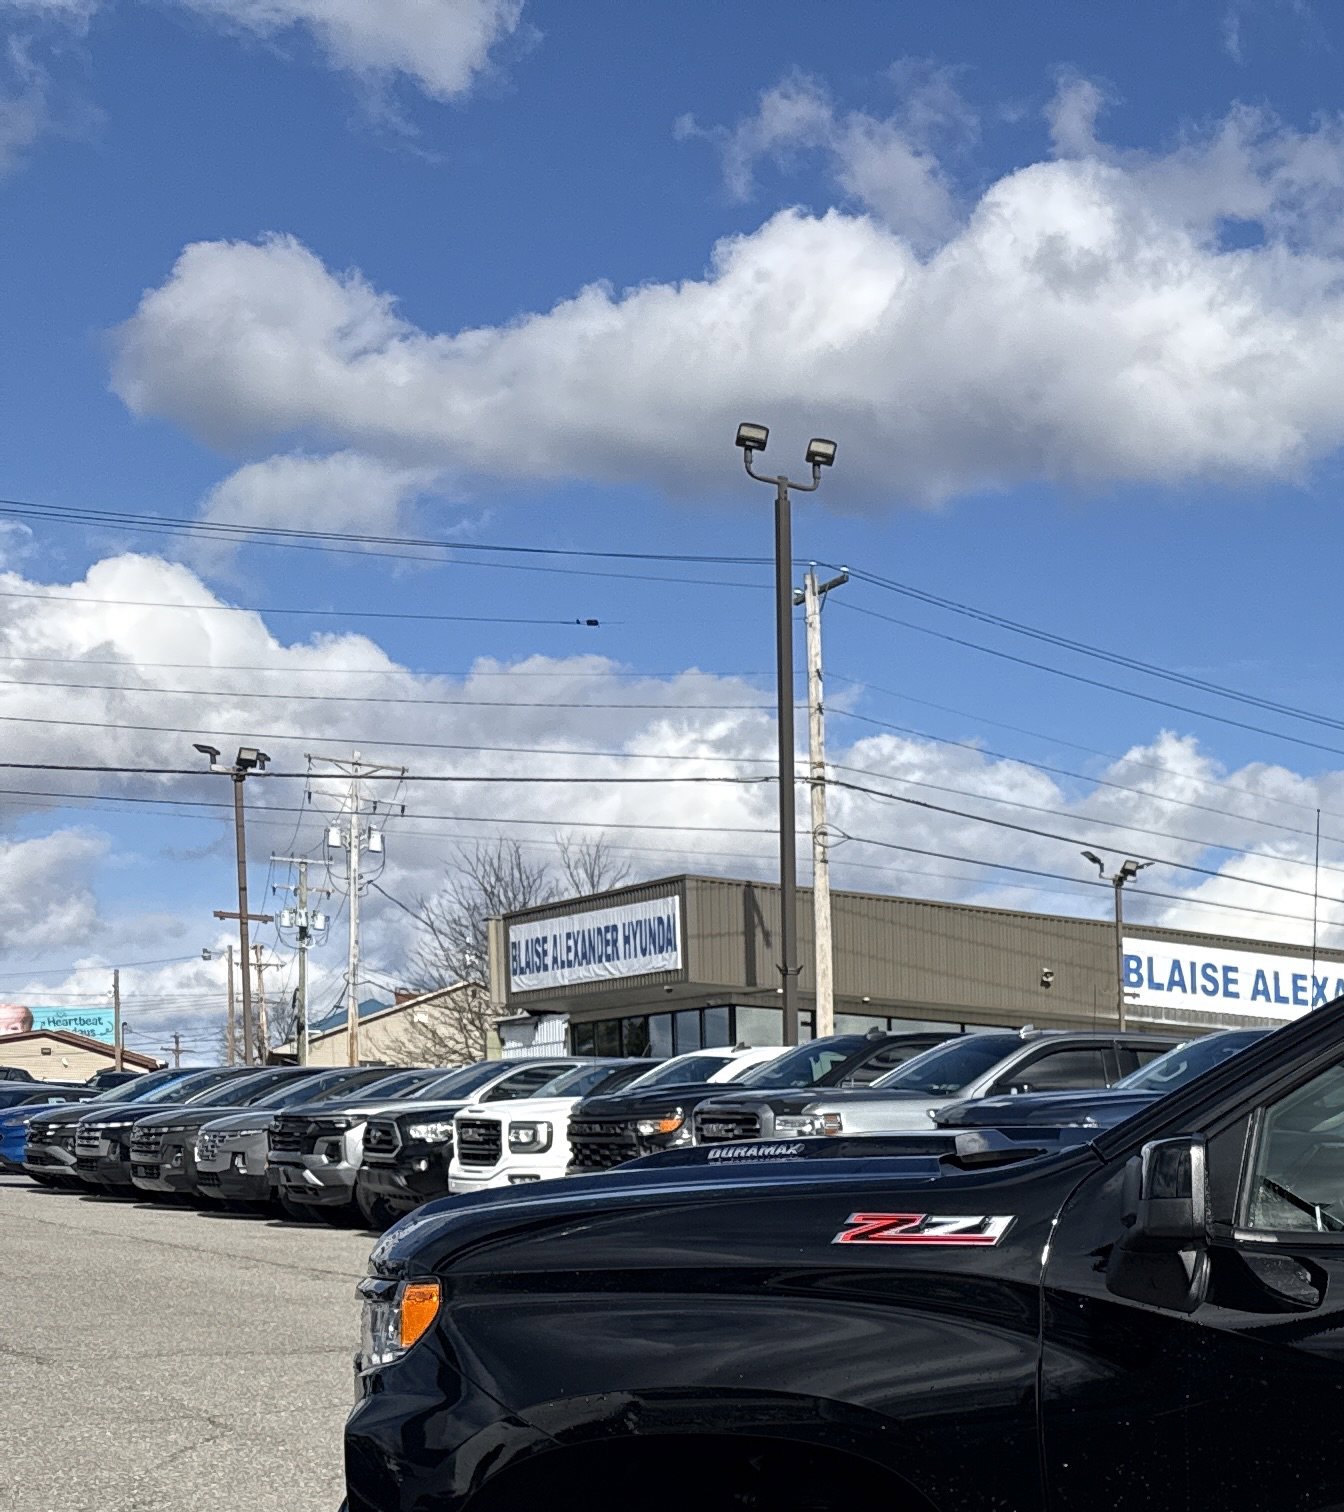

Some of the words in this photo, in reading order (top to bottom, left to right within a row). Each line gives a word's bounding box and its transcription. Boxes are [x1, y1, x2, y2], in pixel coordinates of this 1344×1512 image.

[511, 935, 549, 976] BLAISE
[551, 924, 620, 971] ALEXANDER
[622, 913, 678, 960] HYUNDAI
[1123, 954, 1240, 999] BLAISE
[46, 1016, 104, 1027] Heartbeat
[707, 1143, 805, 1159] DURAMAX
[831, 1213, 1018, 1246] Z71
